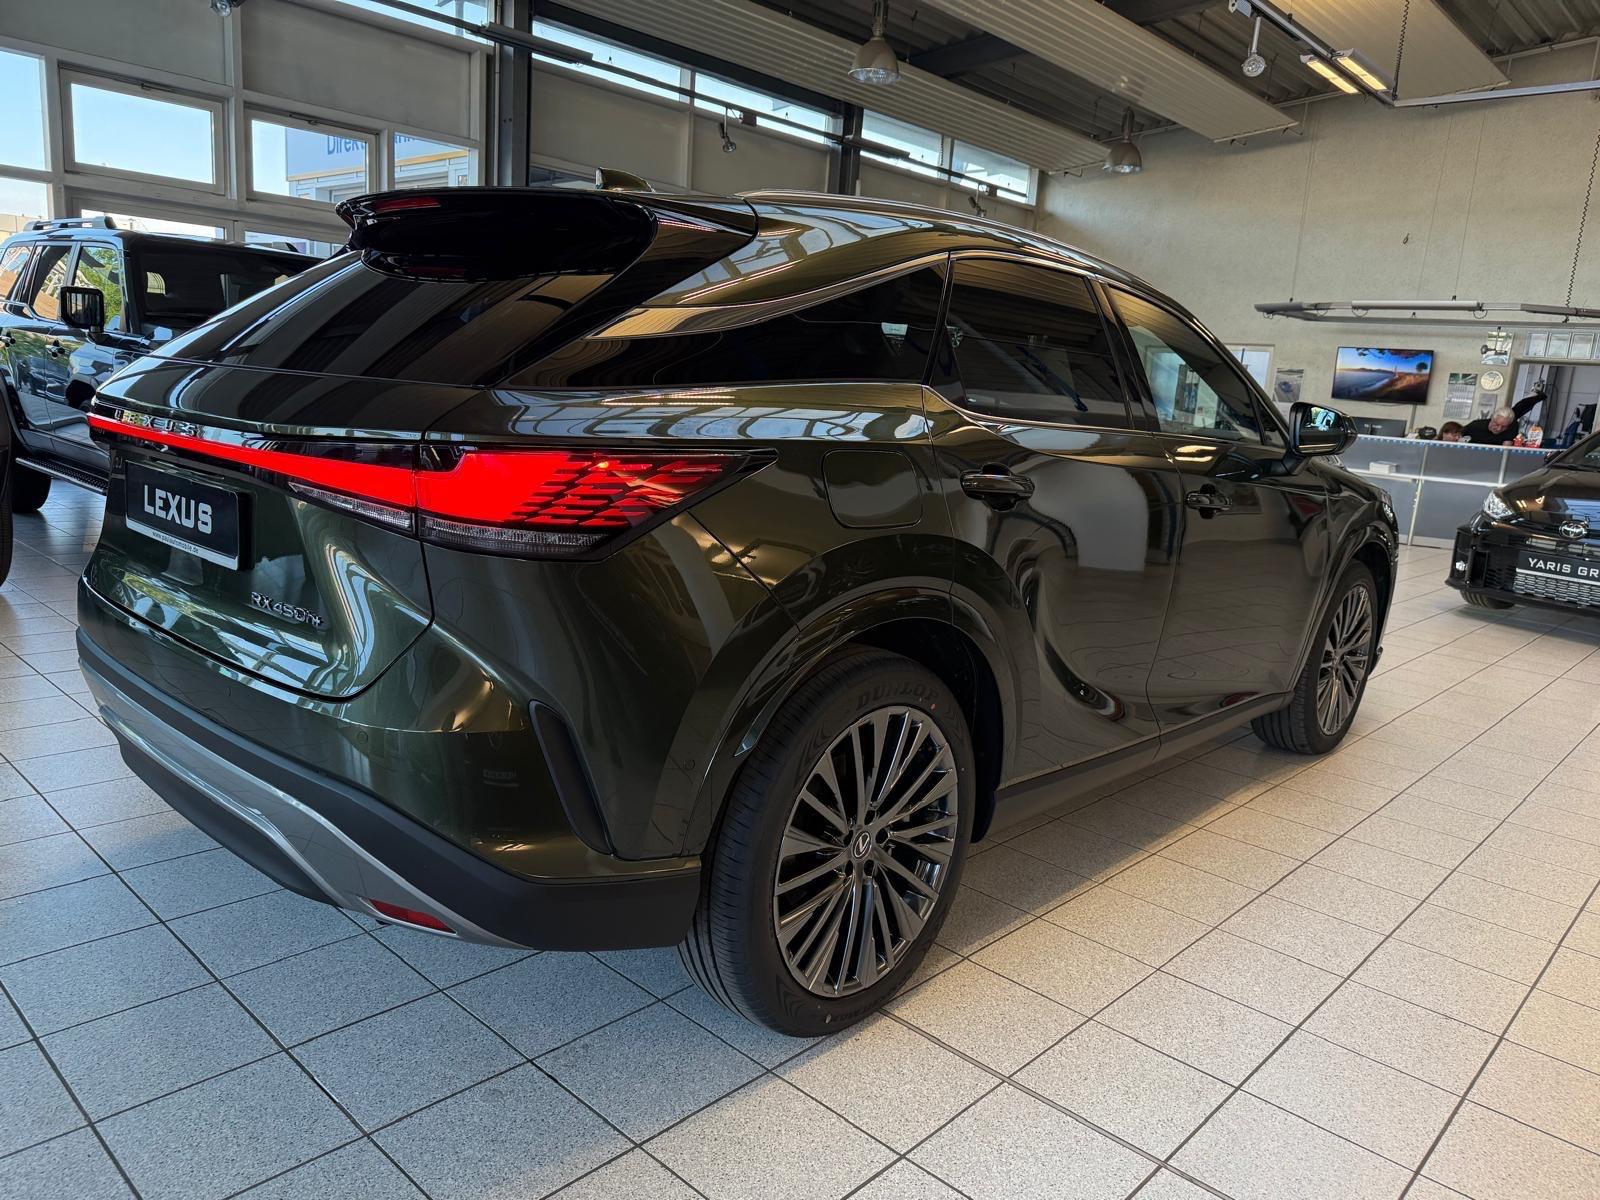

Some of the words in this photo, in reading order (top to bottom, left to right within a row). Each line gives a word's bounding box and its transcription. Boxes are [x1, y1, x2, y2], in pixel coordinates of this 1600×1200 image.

[144, 484, 212, 535] LEXUS
[1528, 557, 1571, 573] YARIS
[1577, 566, 1599, 578] GR
[856, 681, 939, 711] DUNLOP
